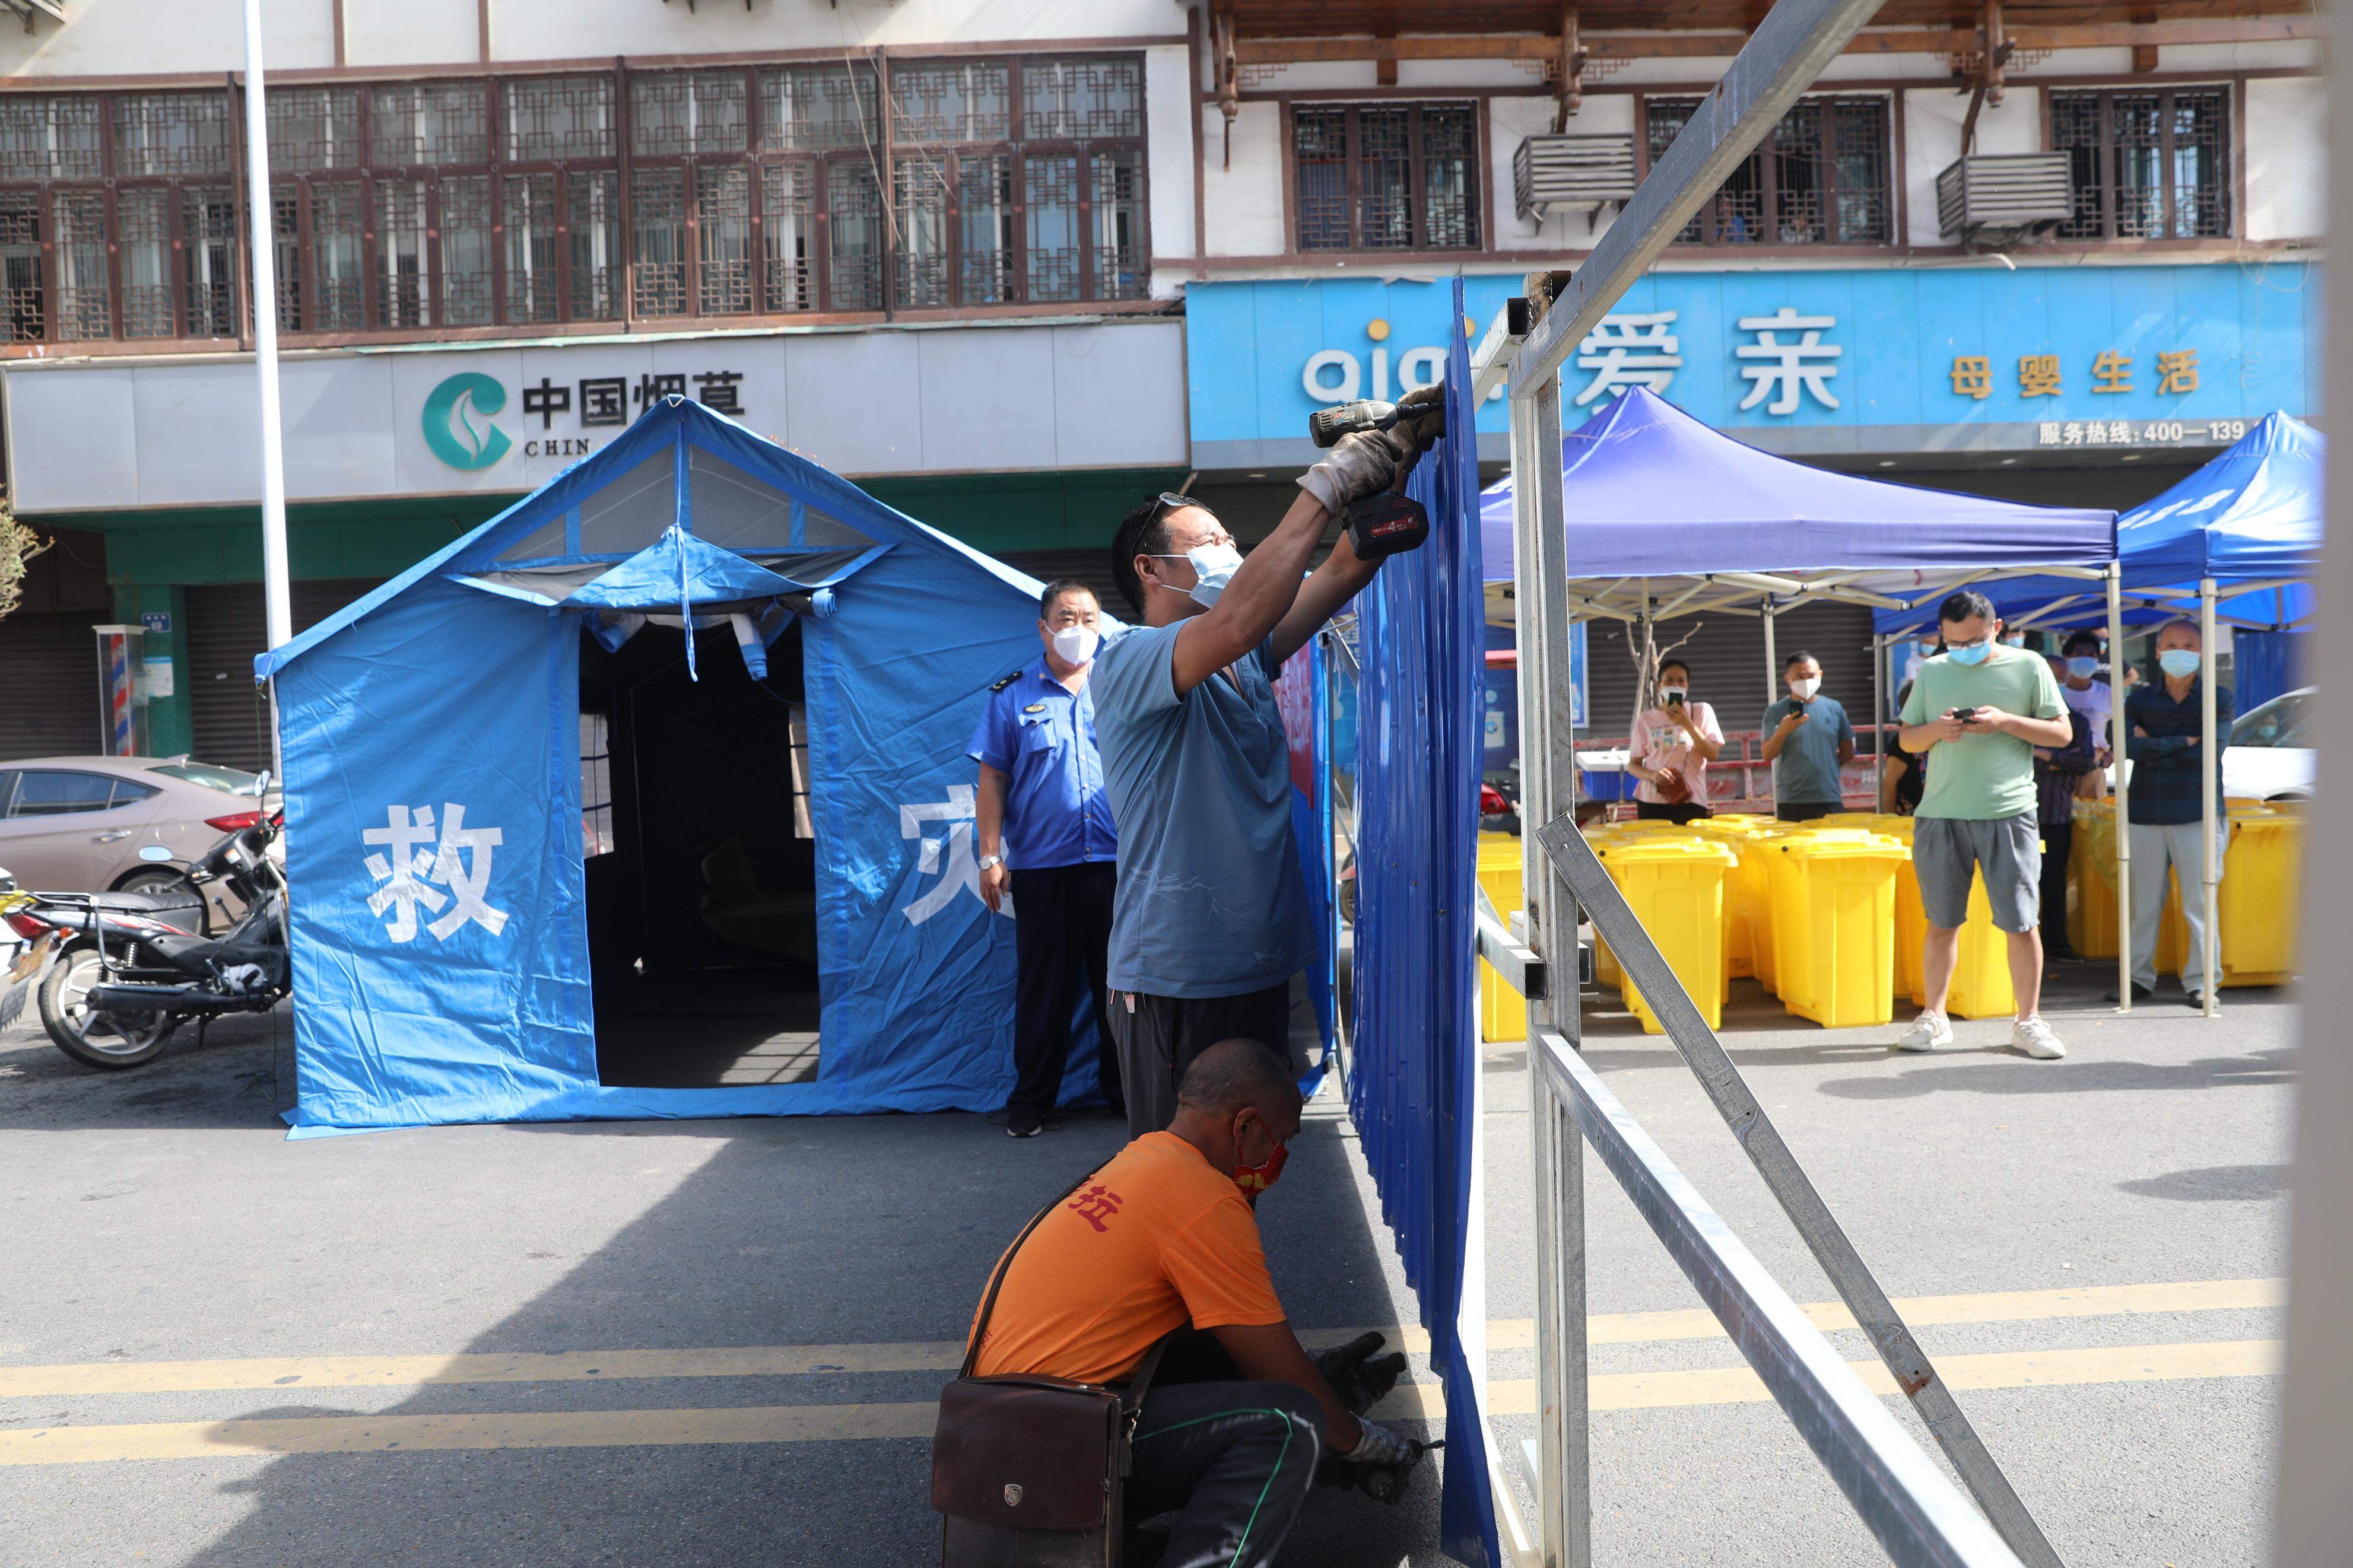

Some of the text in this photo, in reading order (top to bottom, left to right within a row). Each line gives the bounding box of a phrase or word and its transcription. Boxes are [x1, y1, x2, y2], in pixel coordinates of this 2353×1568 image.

[1575, 308, 1841, 415] 爱亲
[1951, 349, 2200, 399] 母婴生活
[363, 802, 509, 943] 救
[1068, 1174, 1123, 1232] 拉
